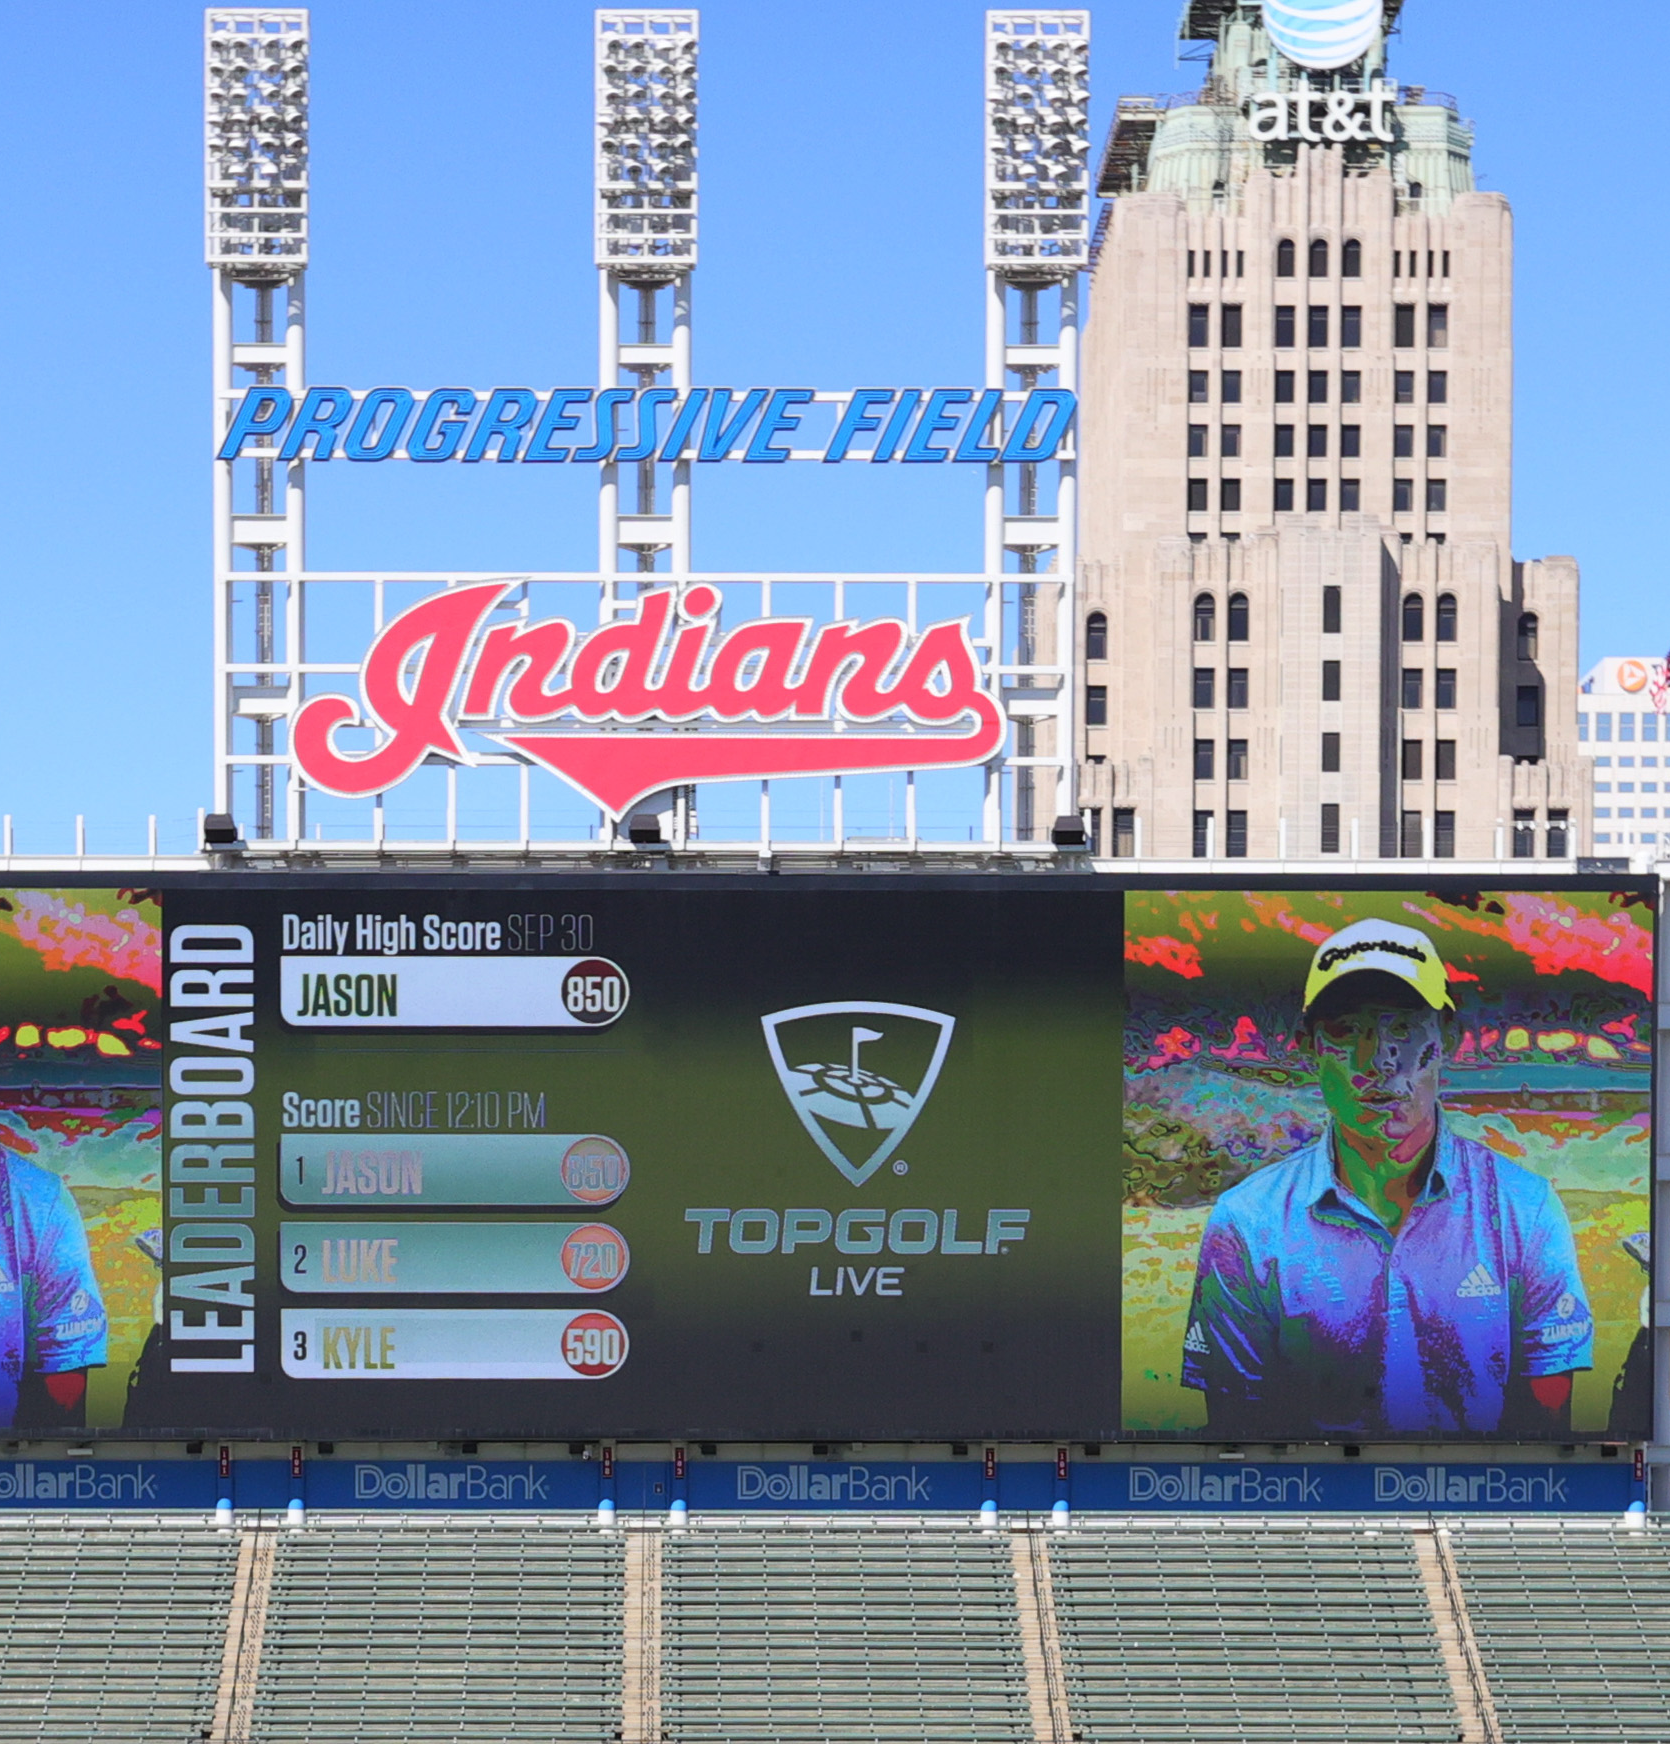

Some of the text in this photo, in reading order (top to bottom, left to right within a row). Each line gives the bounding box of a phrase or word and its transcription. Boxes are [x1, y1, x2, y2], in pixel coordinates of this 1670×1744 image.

[1249, 78, 1397, 142] at&t
[217, 386, 1079, 465] PROGRESSIVE FIELD
[291, 576, 1007, 820] Indians
[282, 913, 594, 956] Daily High Score SEP 30
[296, 973, 621, 1018] JASON 850
[281, 1090, 546, 1130] Score SINCE 12:10 PM
[169, 924, 255, 1374] LEADERBOARD
[295, 1150, 621, 1196] 1 JASON 850
[684, 1207, 1031, 1255] TOPGOLF
[293, 1239, 620, 1284] 2 LUKE 720
[809, 1266, 906, 1297] LIVE
[1455, 1283, 1502, 1299] adidas
[293, 1326, 621, 1371] 3 KYLE 590
[354, 1464, 548, 1501] DollarBank
[736, 1464, 930, 1501] DollarBank
[1129, 1465, 1322, 1503] DollarBank
[1373, 1465, 1568, 1503] DollarBank
